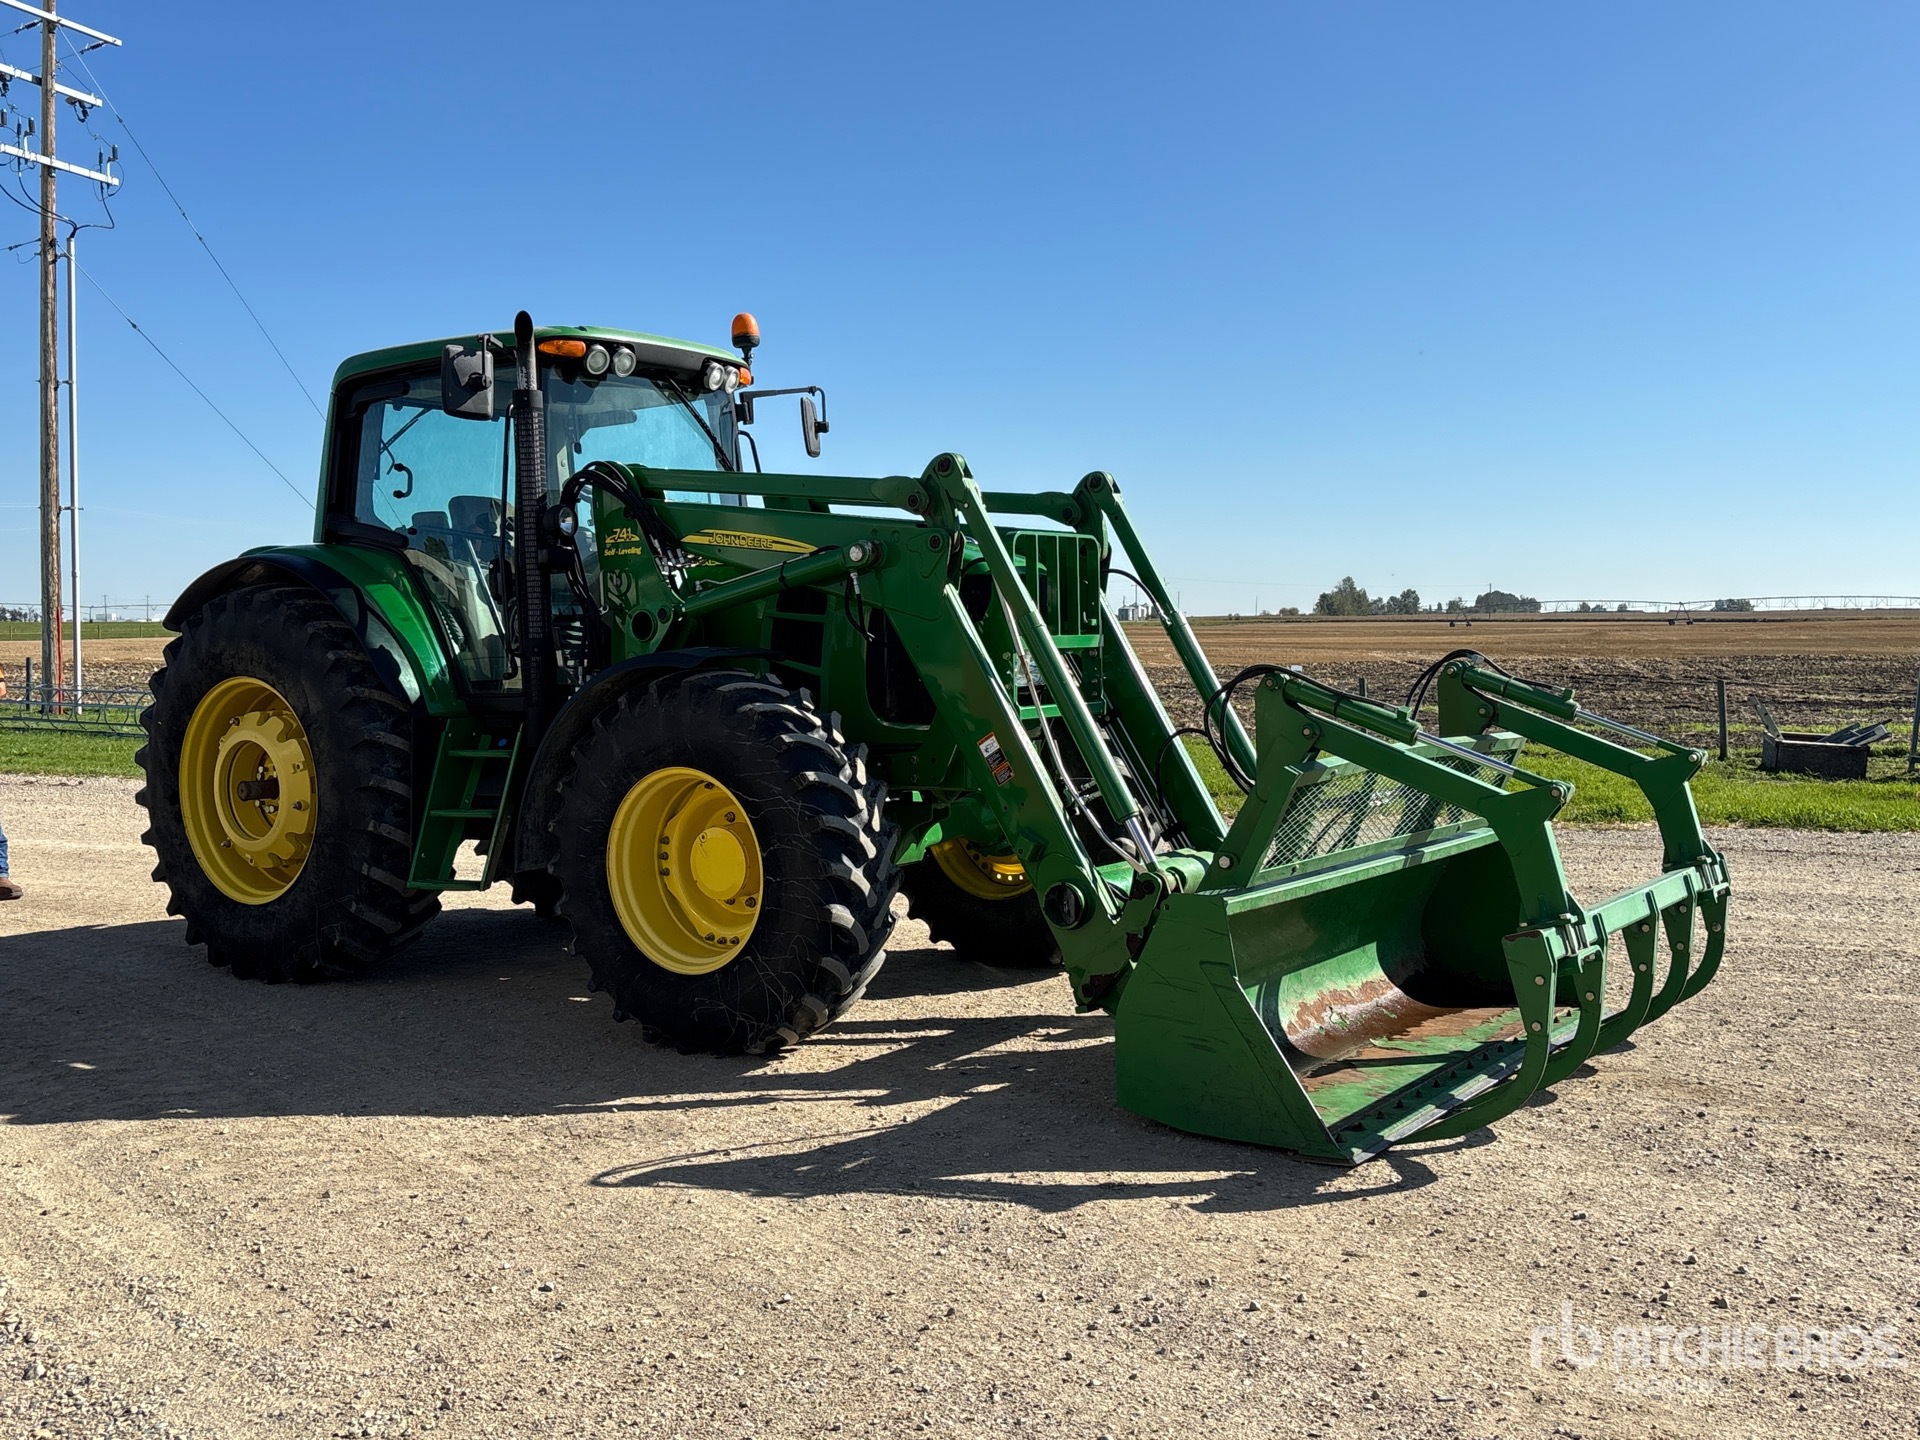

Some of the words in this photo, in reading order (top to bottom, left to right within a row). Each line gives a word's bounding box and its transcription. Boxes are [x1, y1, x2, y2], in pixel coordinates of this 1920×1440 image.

[612, 527, 632, 540] 741
[709, 531, 738, 546] JOHN
[739, 534, 774, 549] DEERE
